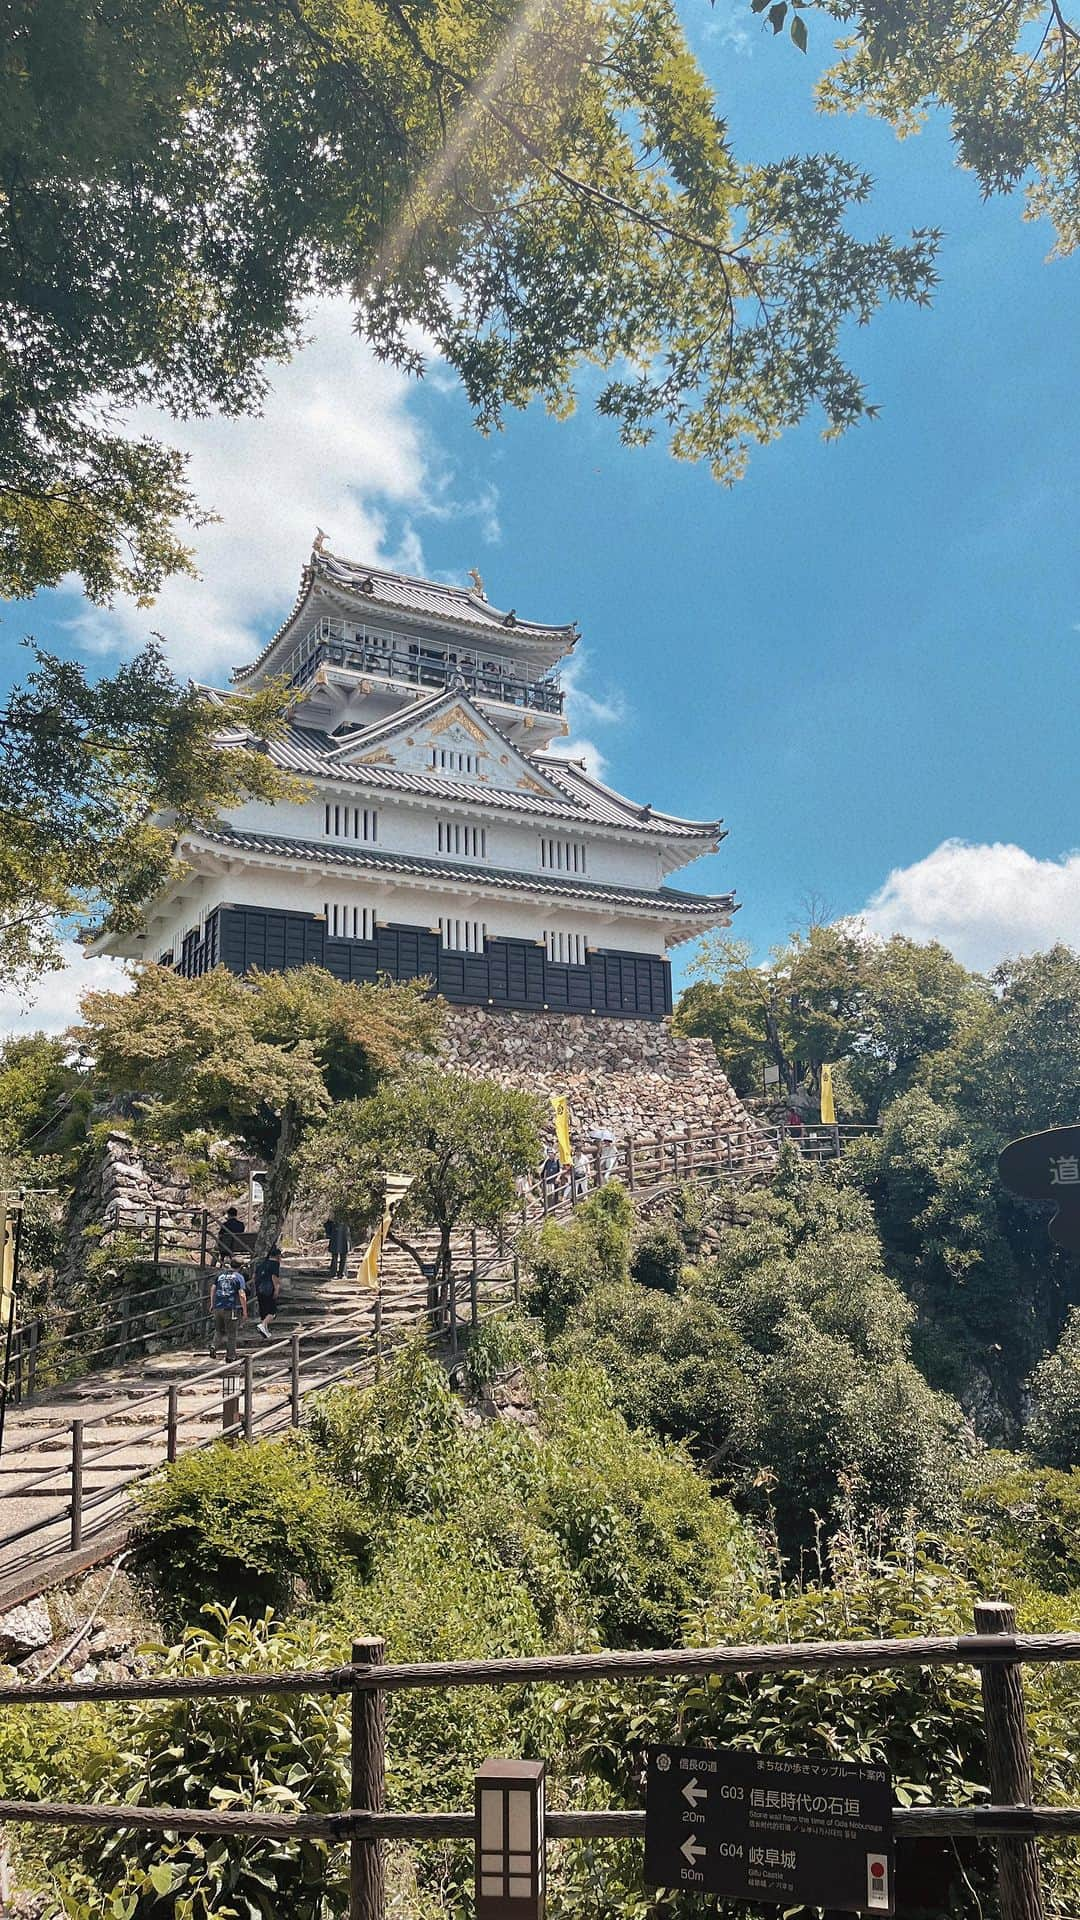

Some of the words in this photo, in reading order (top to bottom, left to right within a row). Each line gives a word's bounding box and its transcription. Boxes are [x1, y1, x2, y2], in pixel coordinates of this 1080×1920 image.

[1049, 1156, 1080, 1184] 道
[680, 1758, 718, 1773] 信長の道
[756, 1760, 886, 1782] まちなか歩きマップルート案内
[720, 1785, 744, 1800] G03
[750, 1788, 860, 1817] 信長時代の石垣
[682, 1811, 705, 1823] 20m
[719, 1842, 743, 1859] G04
[749, 1846, 796, 1870] 岐阜城
[681, 1868, 704, 1882] 50m
